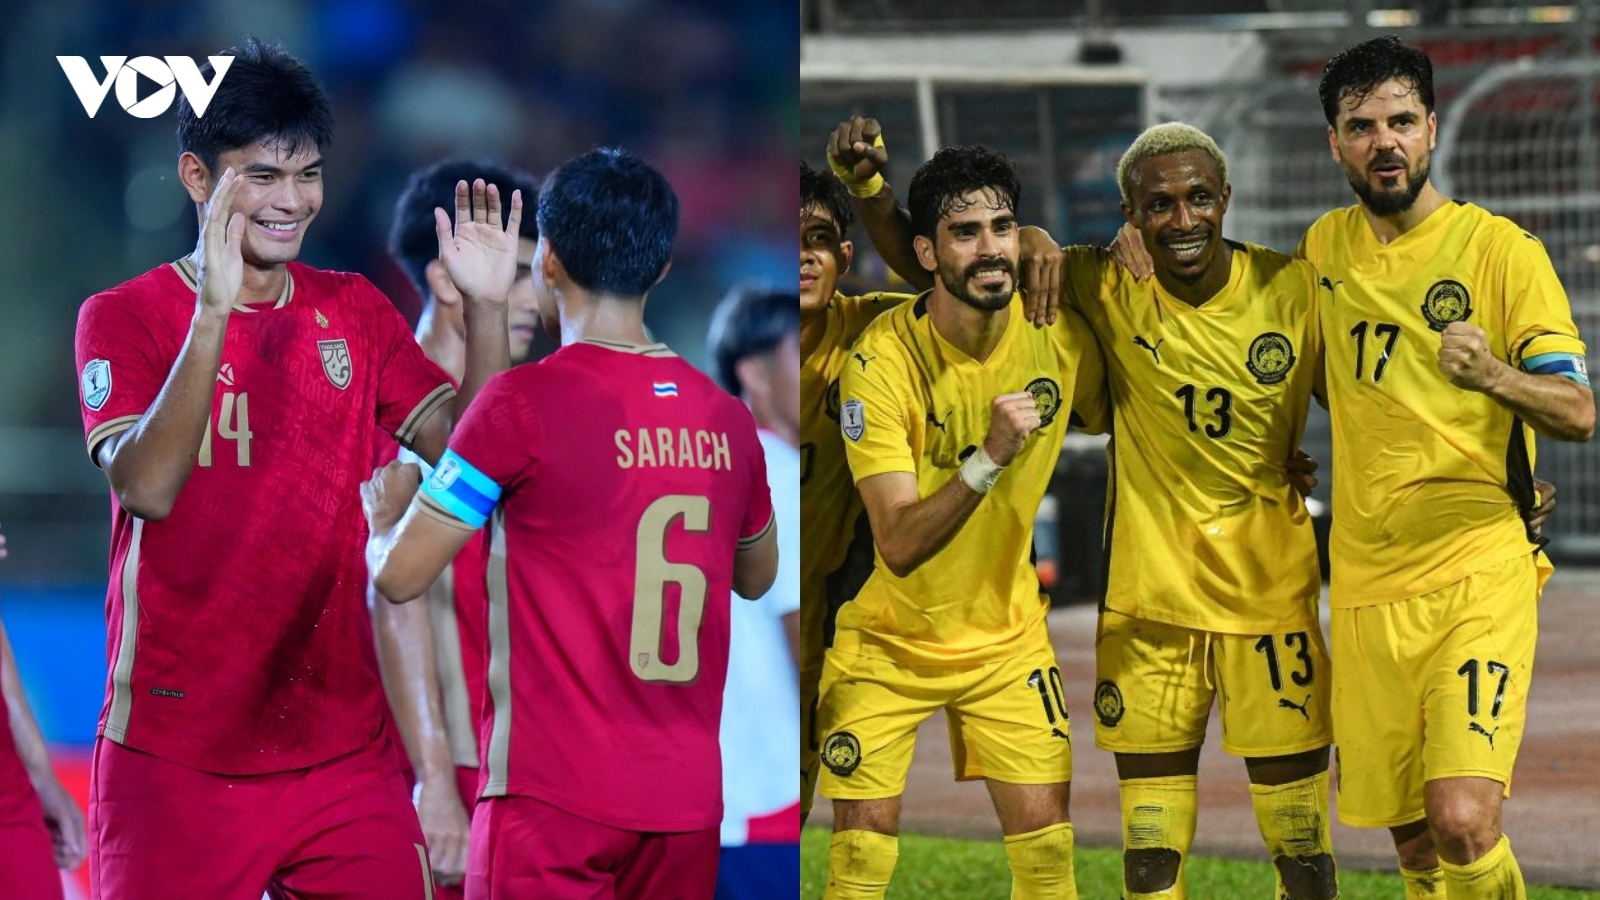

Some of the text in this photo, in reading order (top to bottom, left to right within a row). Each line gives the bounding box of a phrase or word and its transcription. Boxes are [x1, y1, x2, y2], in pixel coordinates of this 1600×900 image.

[1350, 320, 1401, 383] 17
[1175, 383, 1232, 439] 13
[614, 427, 732, 471] SARACH
[629, 494, 711, 685] 6
[1254, 631, 1315, 693] 13
[1457, 658, 1509, 720] 17
[1027, 666, 1069, 726] 10
